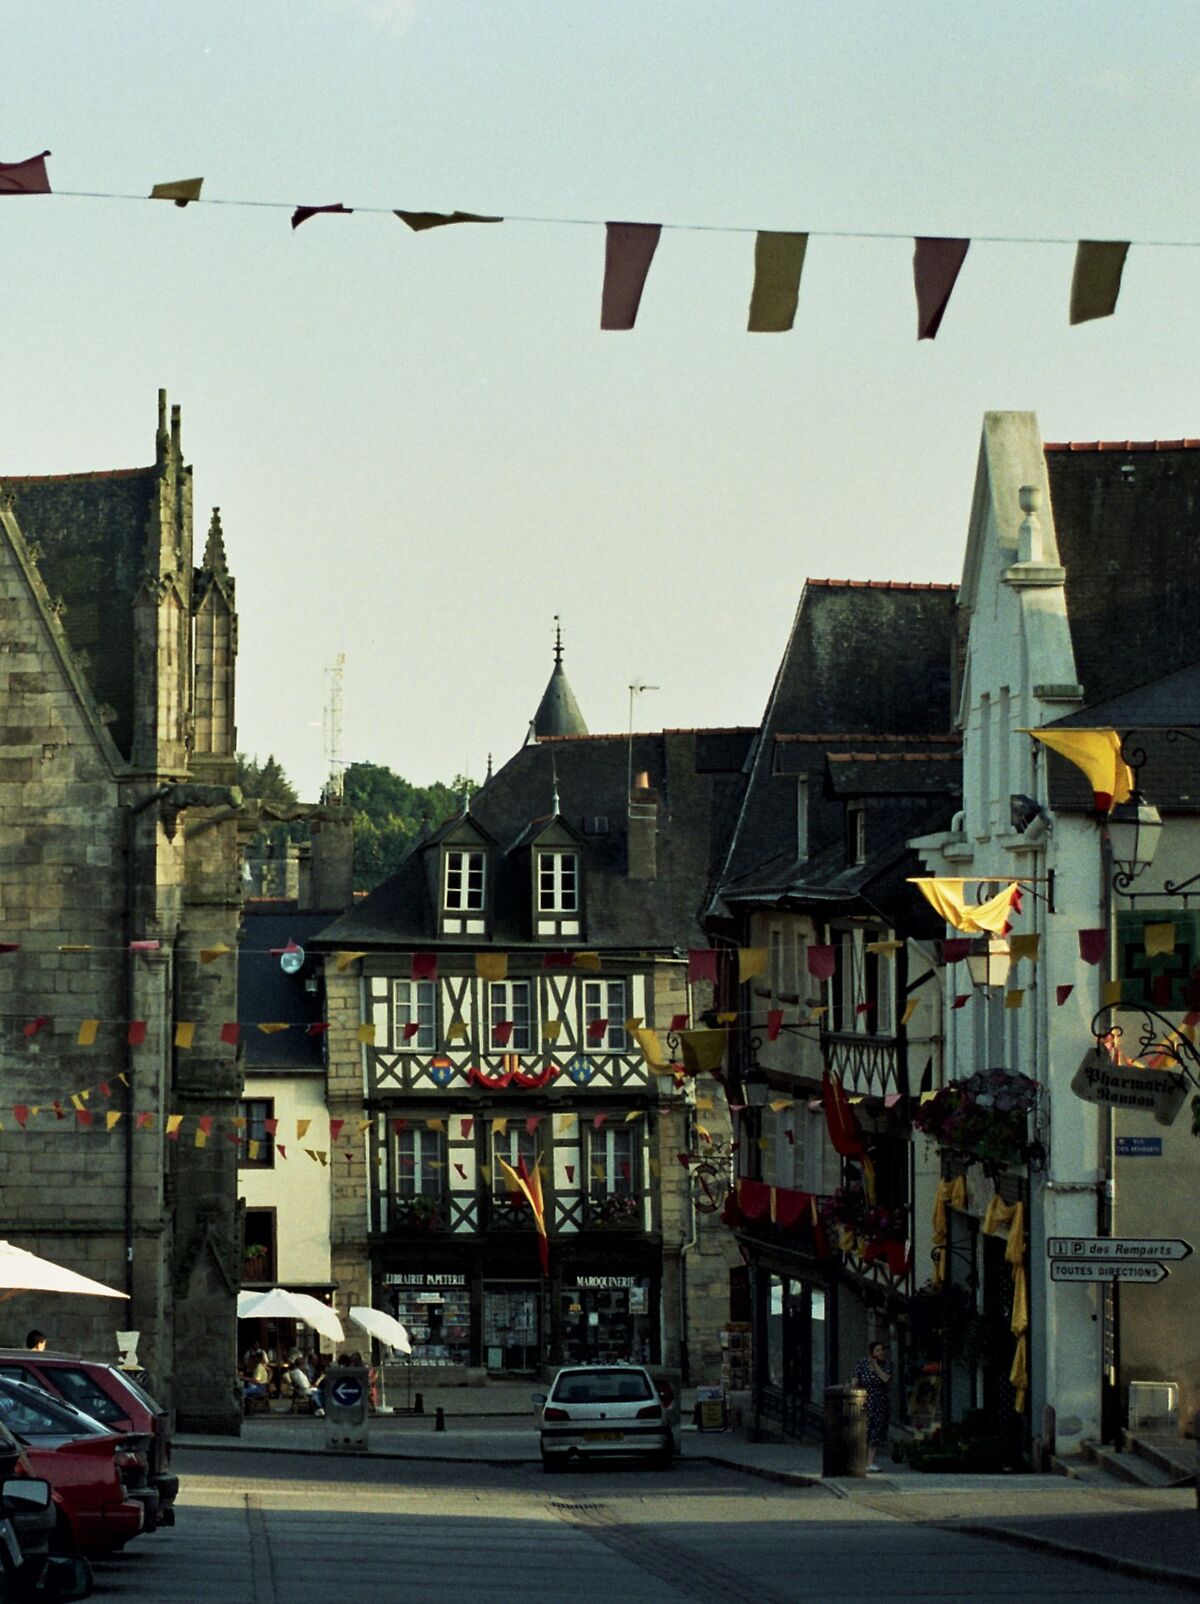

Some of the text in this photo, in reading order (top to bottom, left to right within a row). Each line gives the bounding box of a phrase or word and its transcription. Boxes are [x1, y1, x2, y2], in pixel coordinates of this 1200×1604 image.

[1089, 1243, 1110, 1254] des
[1115, 1244, 1172, 1257] Remparts
[1055, 1266, 1159, 1277] TOUTES DIRECTIONS
[386, 1273, 466, 1286] LIBRAIRIE PAPETERIE
[576, 1275, 636, 1289] MAROQUINERIE
